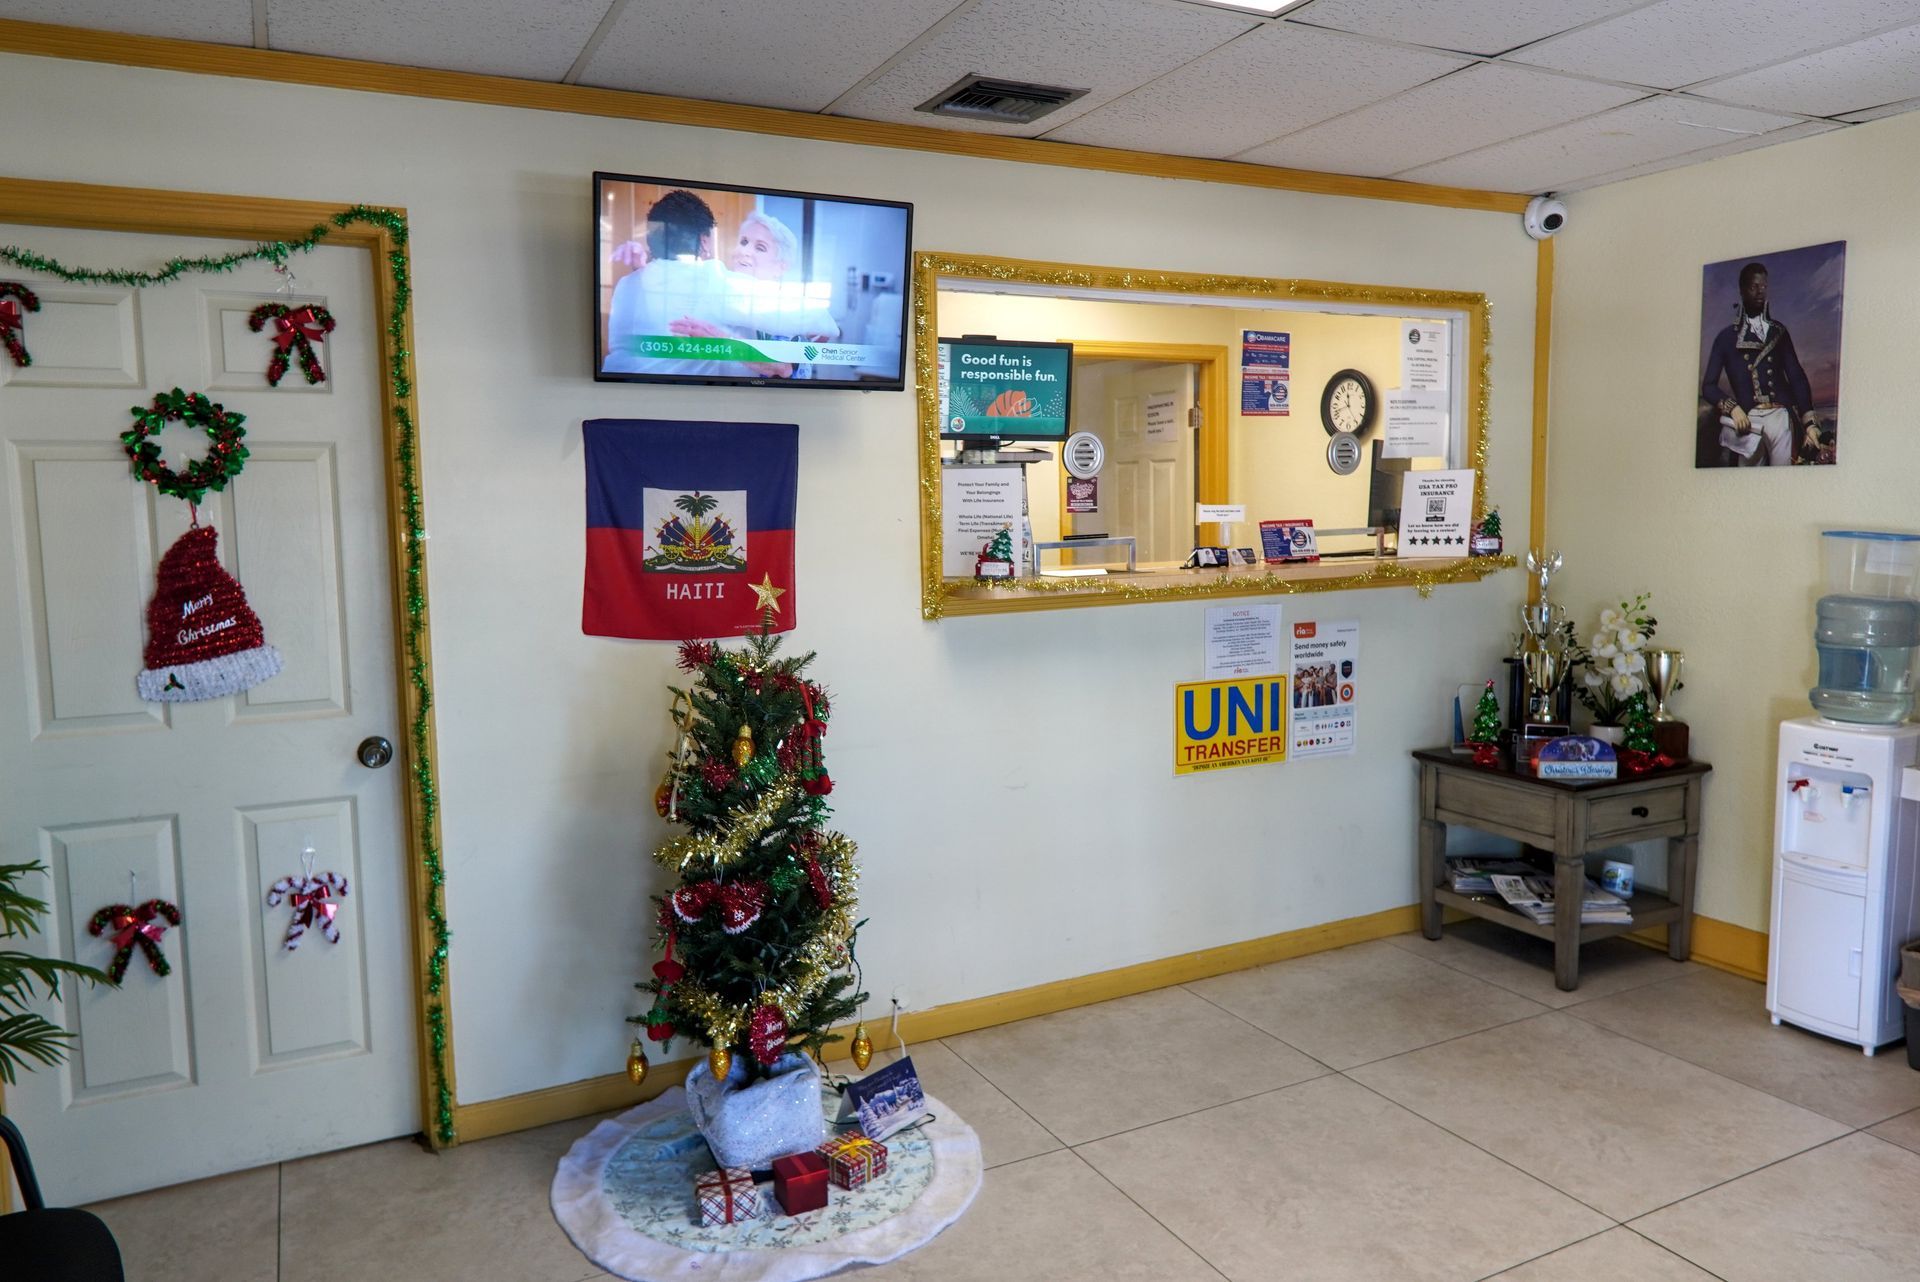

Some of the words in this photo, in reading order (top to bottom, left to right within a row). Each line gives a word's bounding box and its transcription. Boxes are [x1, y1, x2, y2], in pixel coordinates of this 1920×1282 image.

[640, 342, 674, 353] (305)
[677, 342, 732, 354] 424-8414
[961, 354, 996, 366] Good
[999, 354, 1020, 366] fun
[1022, 356, 1032, 367] is
[961, 369, 1032, 382] responsible
[1034, 370, 1058, 382] fun.
[667, 583, 725, 600] HAITI
[182, 593, 213, 619] Merry
[177, 616, 237, 645] Christmas
[1296, 627, 1306, 635] ria
[1295, 651, 1323, 659] worldwide
[1184, 682, 1280, 740] UNI
[1184, 736, 1280, 762] TRANSFER
